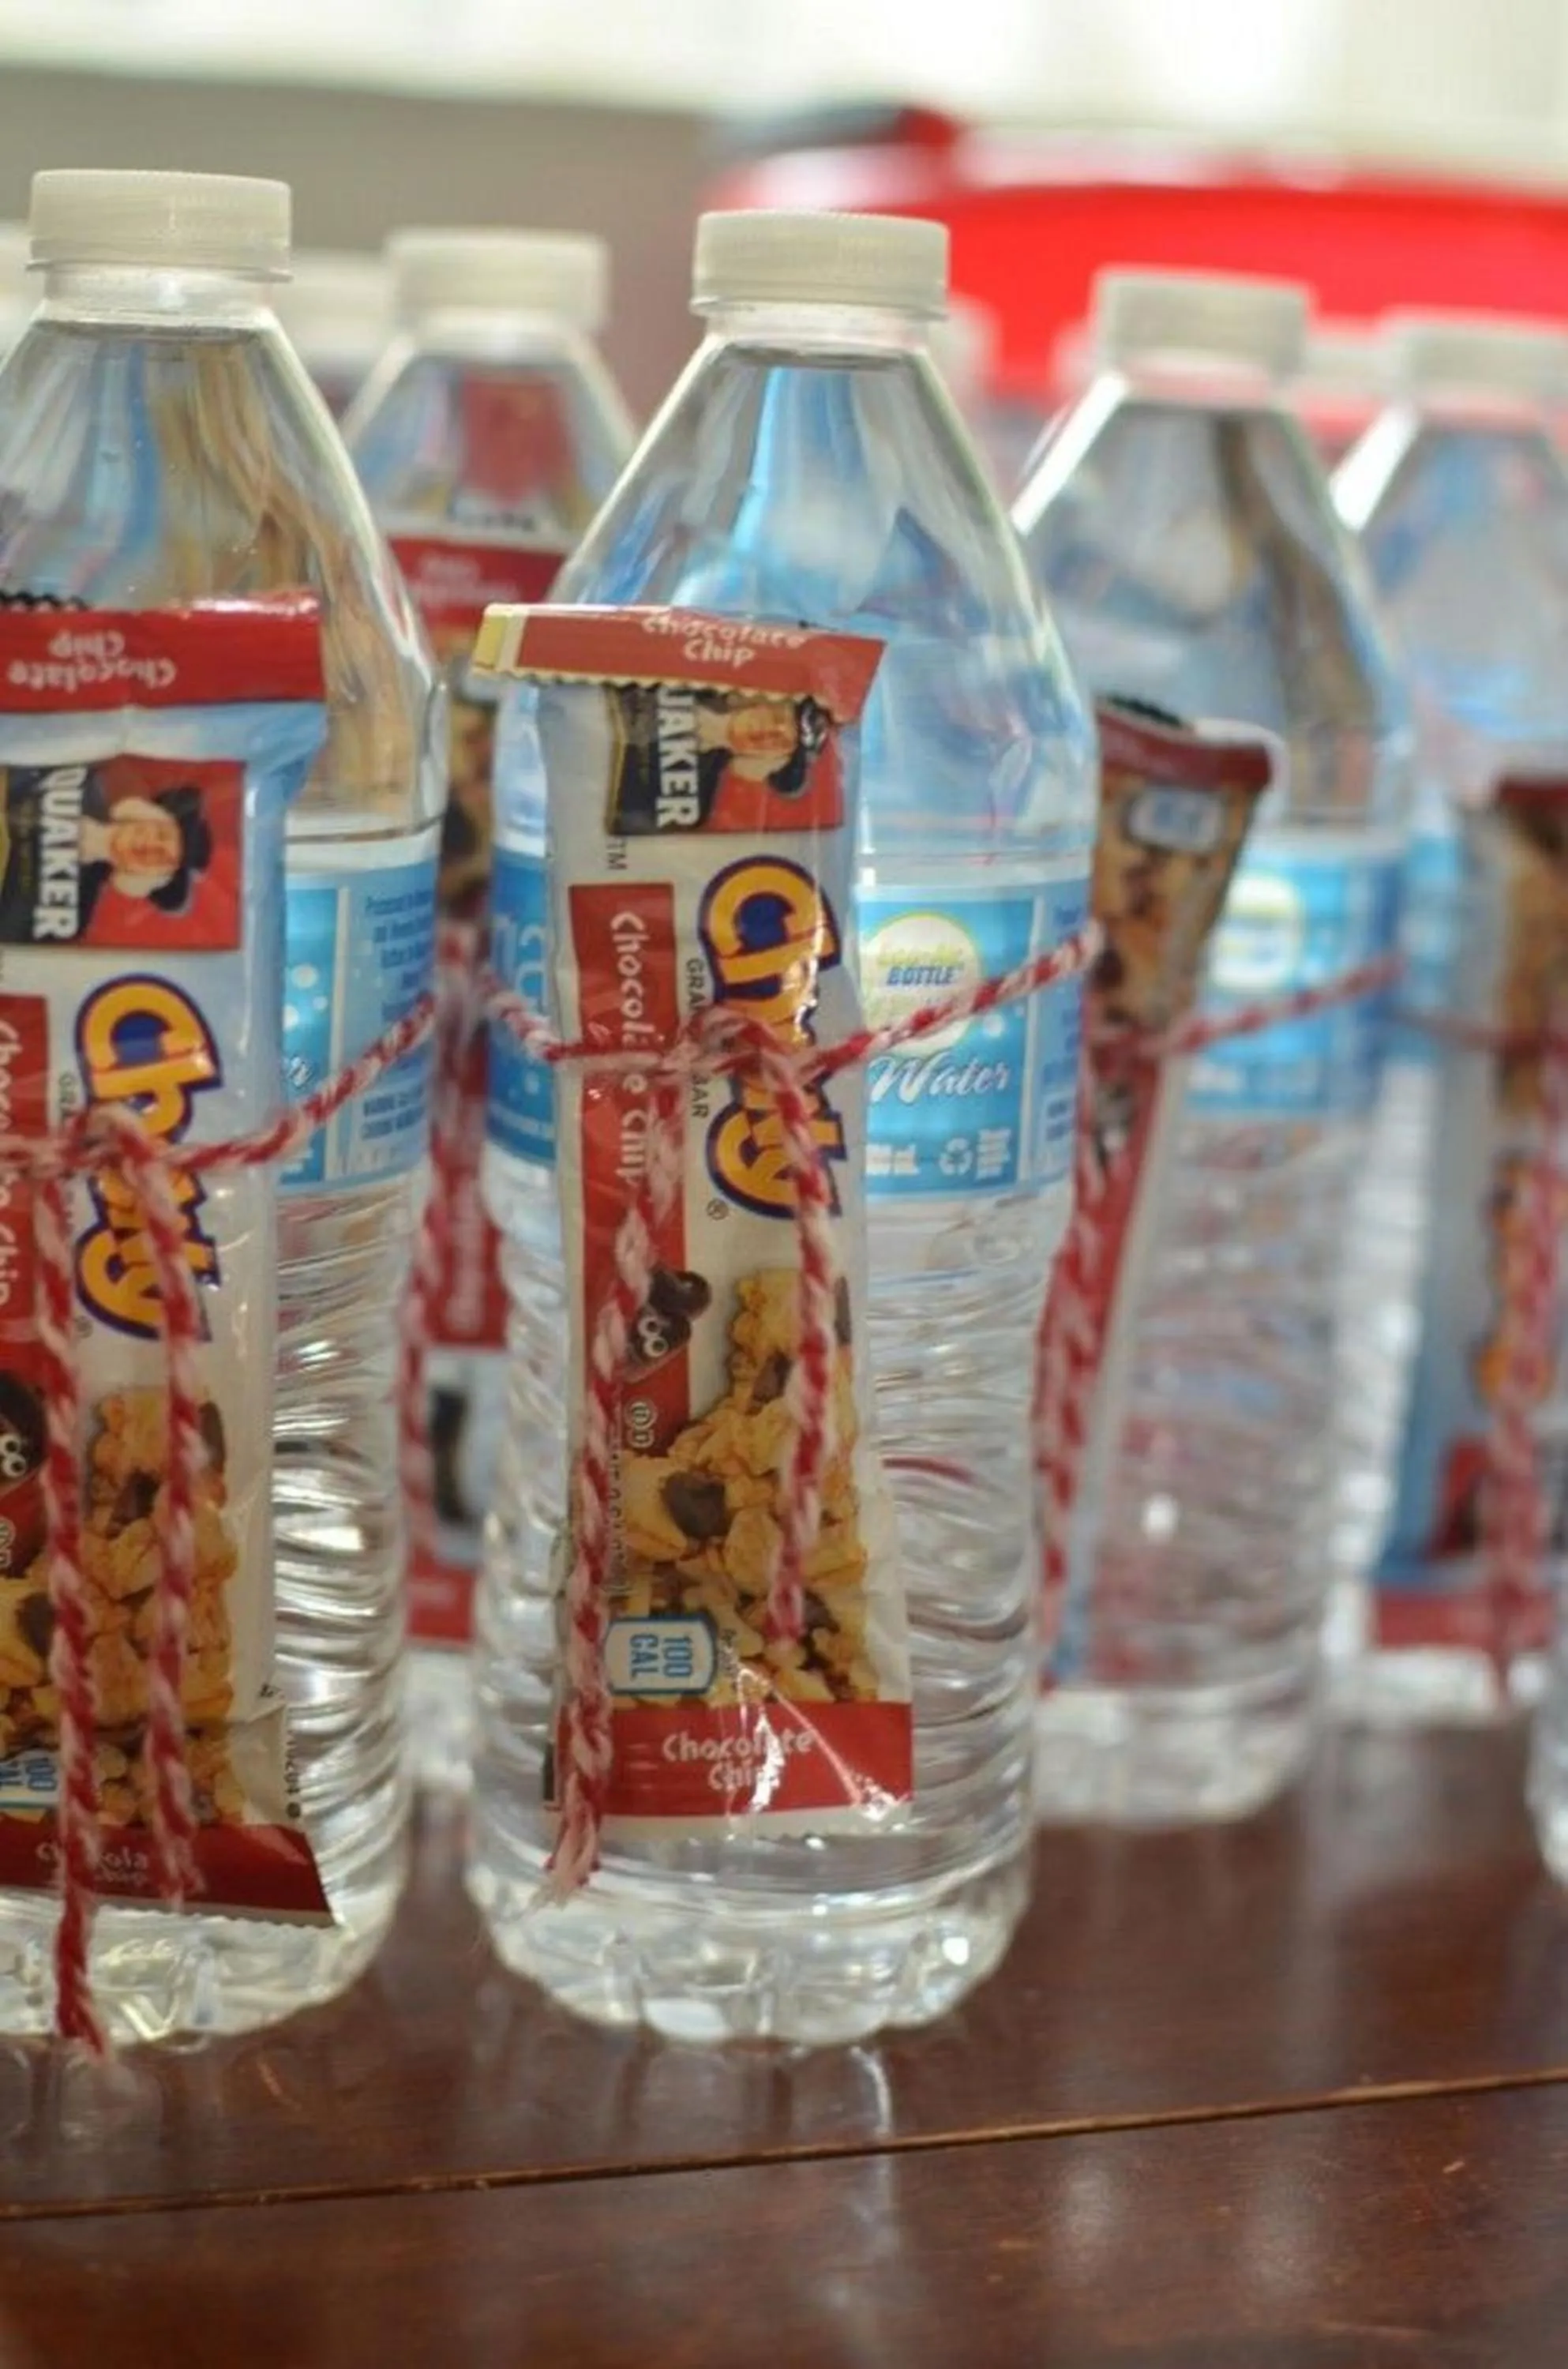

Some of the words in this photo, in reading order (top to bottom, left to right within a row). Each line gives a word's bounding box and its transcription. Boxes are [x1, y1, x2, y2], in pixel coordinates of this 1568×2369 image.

[48, 629, 125, 658] Chip
[683, 639, 756, 667] Chip
[7, 656, 177, 693] Chocolate
[657, 686, 700, 828] UAKER
[32, 766, 87, 940] QUAKER
[610, 912, 655, 1094] Chocole
[869, 1049, 1011, 1103] Water
[629, 1633, 660, 1679] CAL
[662, 1635, 694, 1678] 100
[662, 1727, 818, 1762] Chocolte
